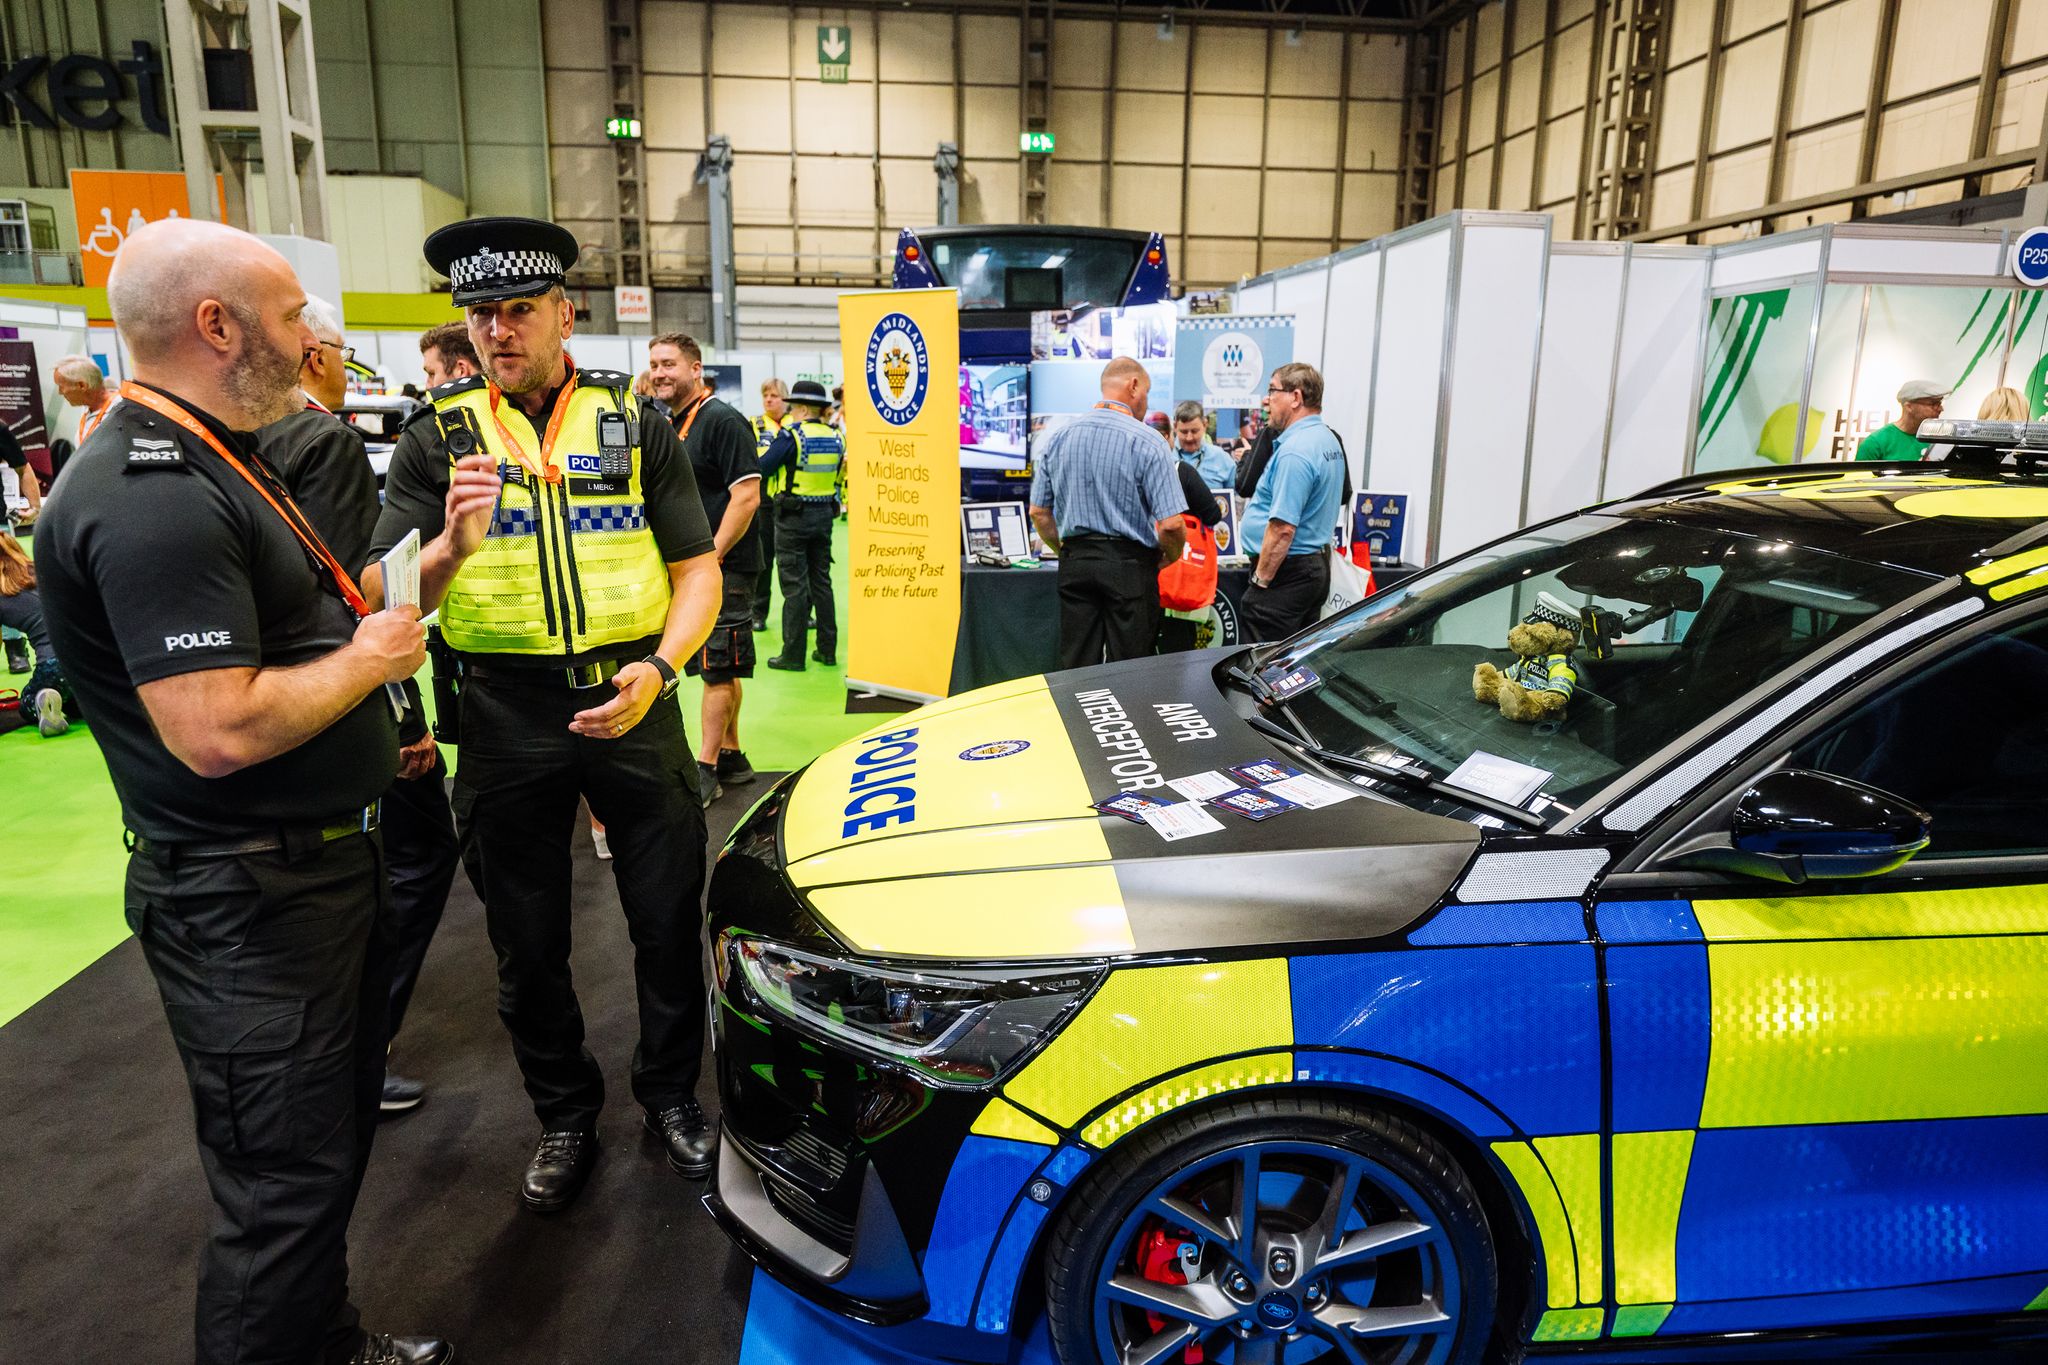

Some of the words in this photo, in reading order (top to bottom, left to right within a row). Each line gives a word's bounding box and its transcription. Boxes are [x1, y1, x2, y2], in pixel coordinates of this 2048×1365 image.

[822, 64, 847, 80] EXIT
[621, 291, 645, 302] Fire
[620, 305, 648, 315] point
[866, 331, 881, 374] WEST
[882, 317, 927, 374] MIDLANDS
[877, 400, 919, 423] POLICE
[128, 450, 180, 461] 20621
[879, 439, 915, 458] West
[571, 457, 601, 470] POLI
[866, 461, 930, 482] Midlands
[593, 483, 614, 491] MERC
[877, 484, 919, 504] Police
[868, 506, 929, 528] Museum
[868, 543, 926, 560] Preserving
[854, 567, 871, 578] our
[874, 564, 916, 582] Policing
[919, 563, 944, 577] Past
[863, 585, 879, 598] for
[881, 585, 899, 598] the
[903, 585, 938, 598] Future
[1215, 601, 1236, 639] ANDS
[164, 631, 232, 652] POLICE
[1152, 702, 1218, 743] ANPR
[1074, 688, 1166, 793] INTERCEPTOR
[842, 727, 919, 839] POLICE
